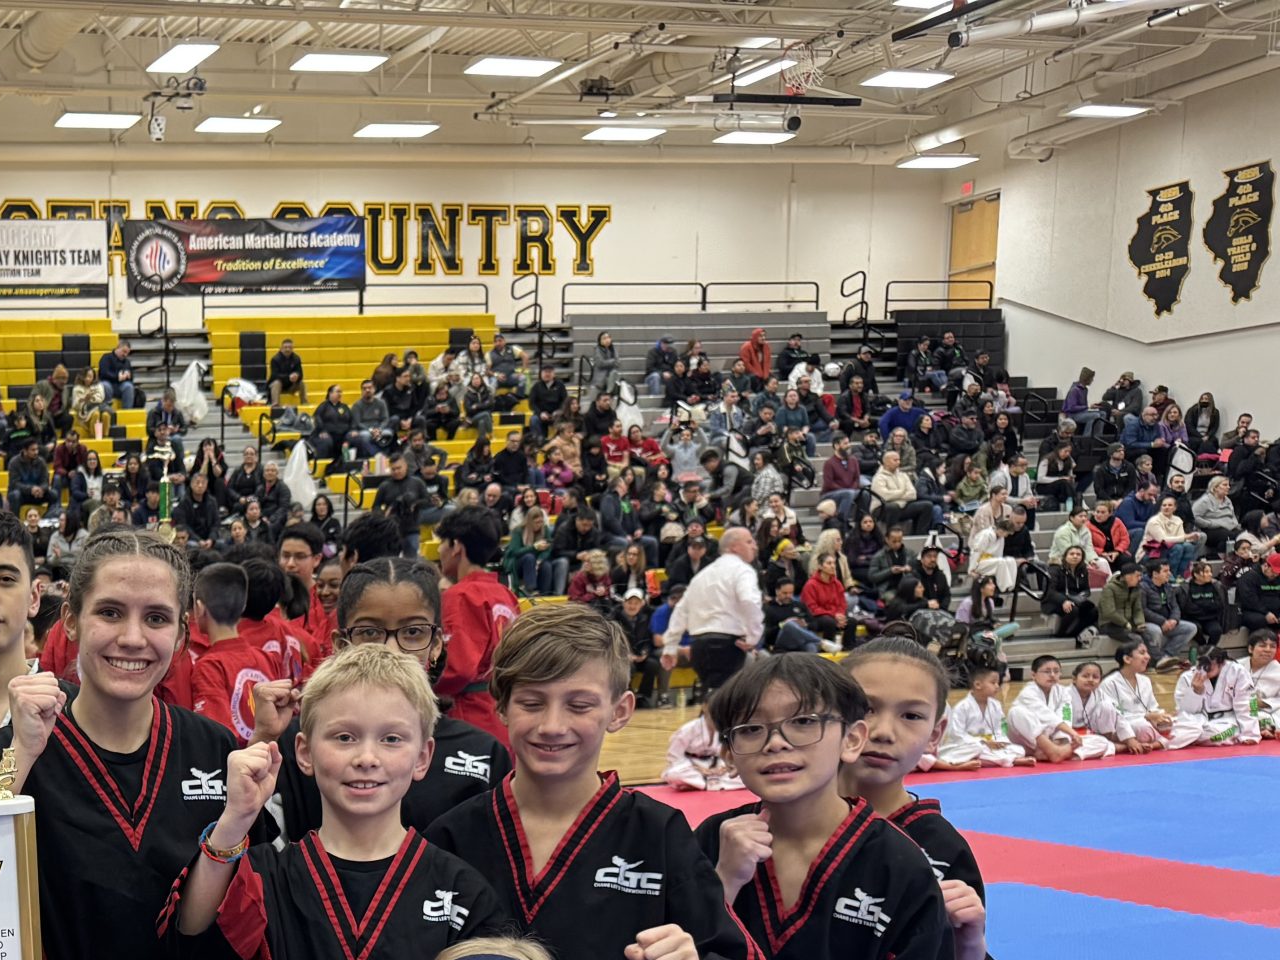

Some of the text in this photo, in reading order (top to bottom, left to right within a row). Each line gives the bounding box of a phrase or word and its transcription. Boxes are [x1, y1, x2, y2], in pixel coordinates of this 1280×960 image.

[1228, 192, 1260, 207] PLACE
[1151, 210, 1180, 225] PLACE
[188, 232, 361, 250] American Martial Arts Academy
[1227, 244, 1251, 256] TRACK
[13, 250, 67, 266] KNIGHTS
[71, 250, 102, 266] TEAM
[262, 259, 274, 270] of
[22, 268, 41, 278] TEAM
